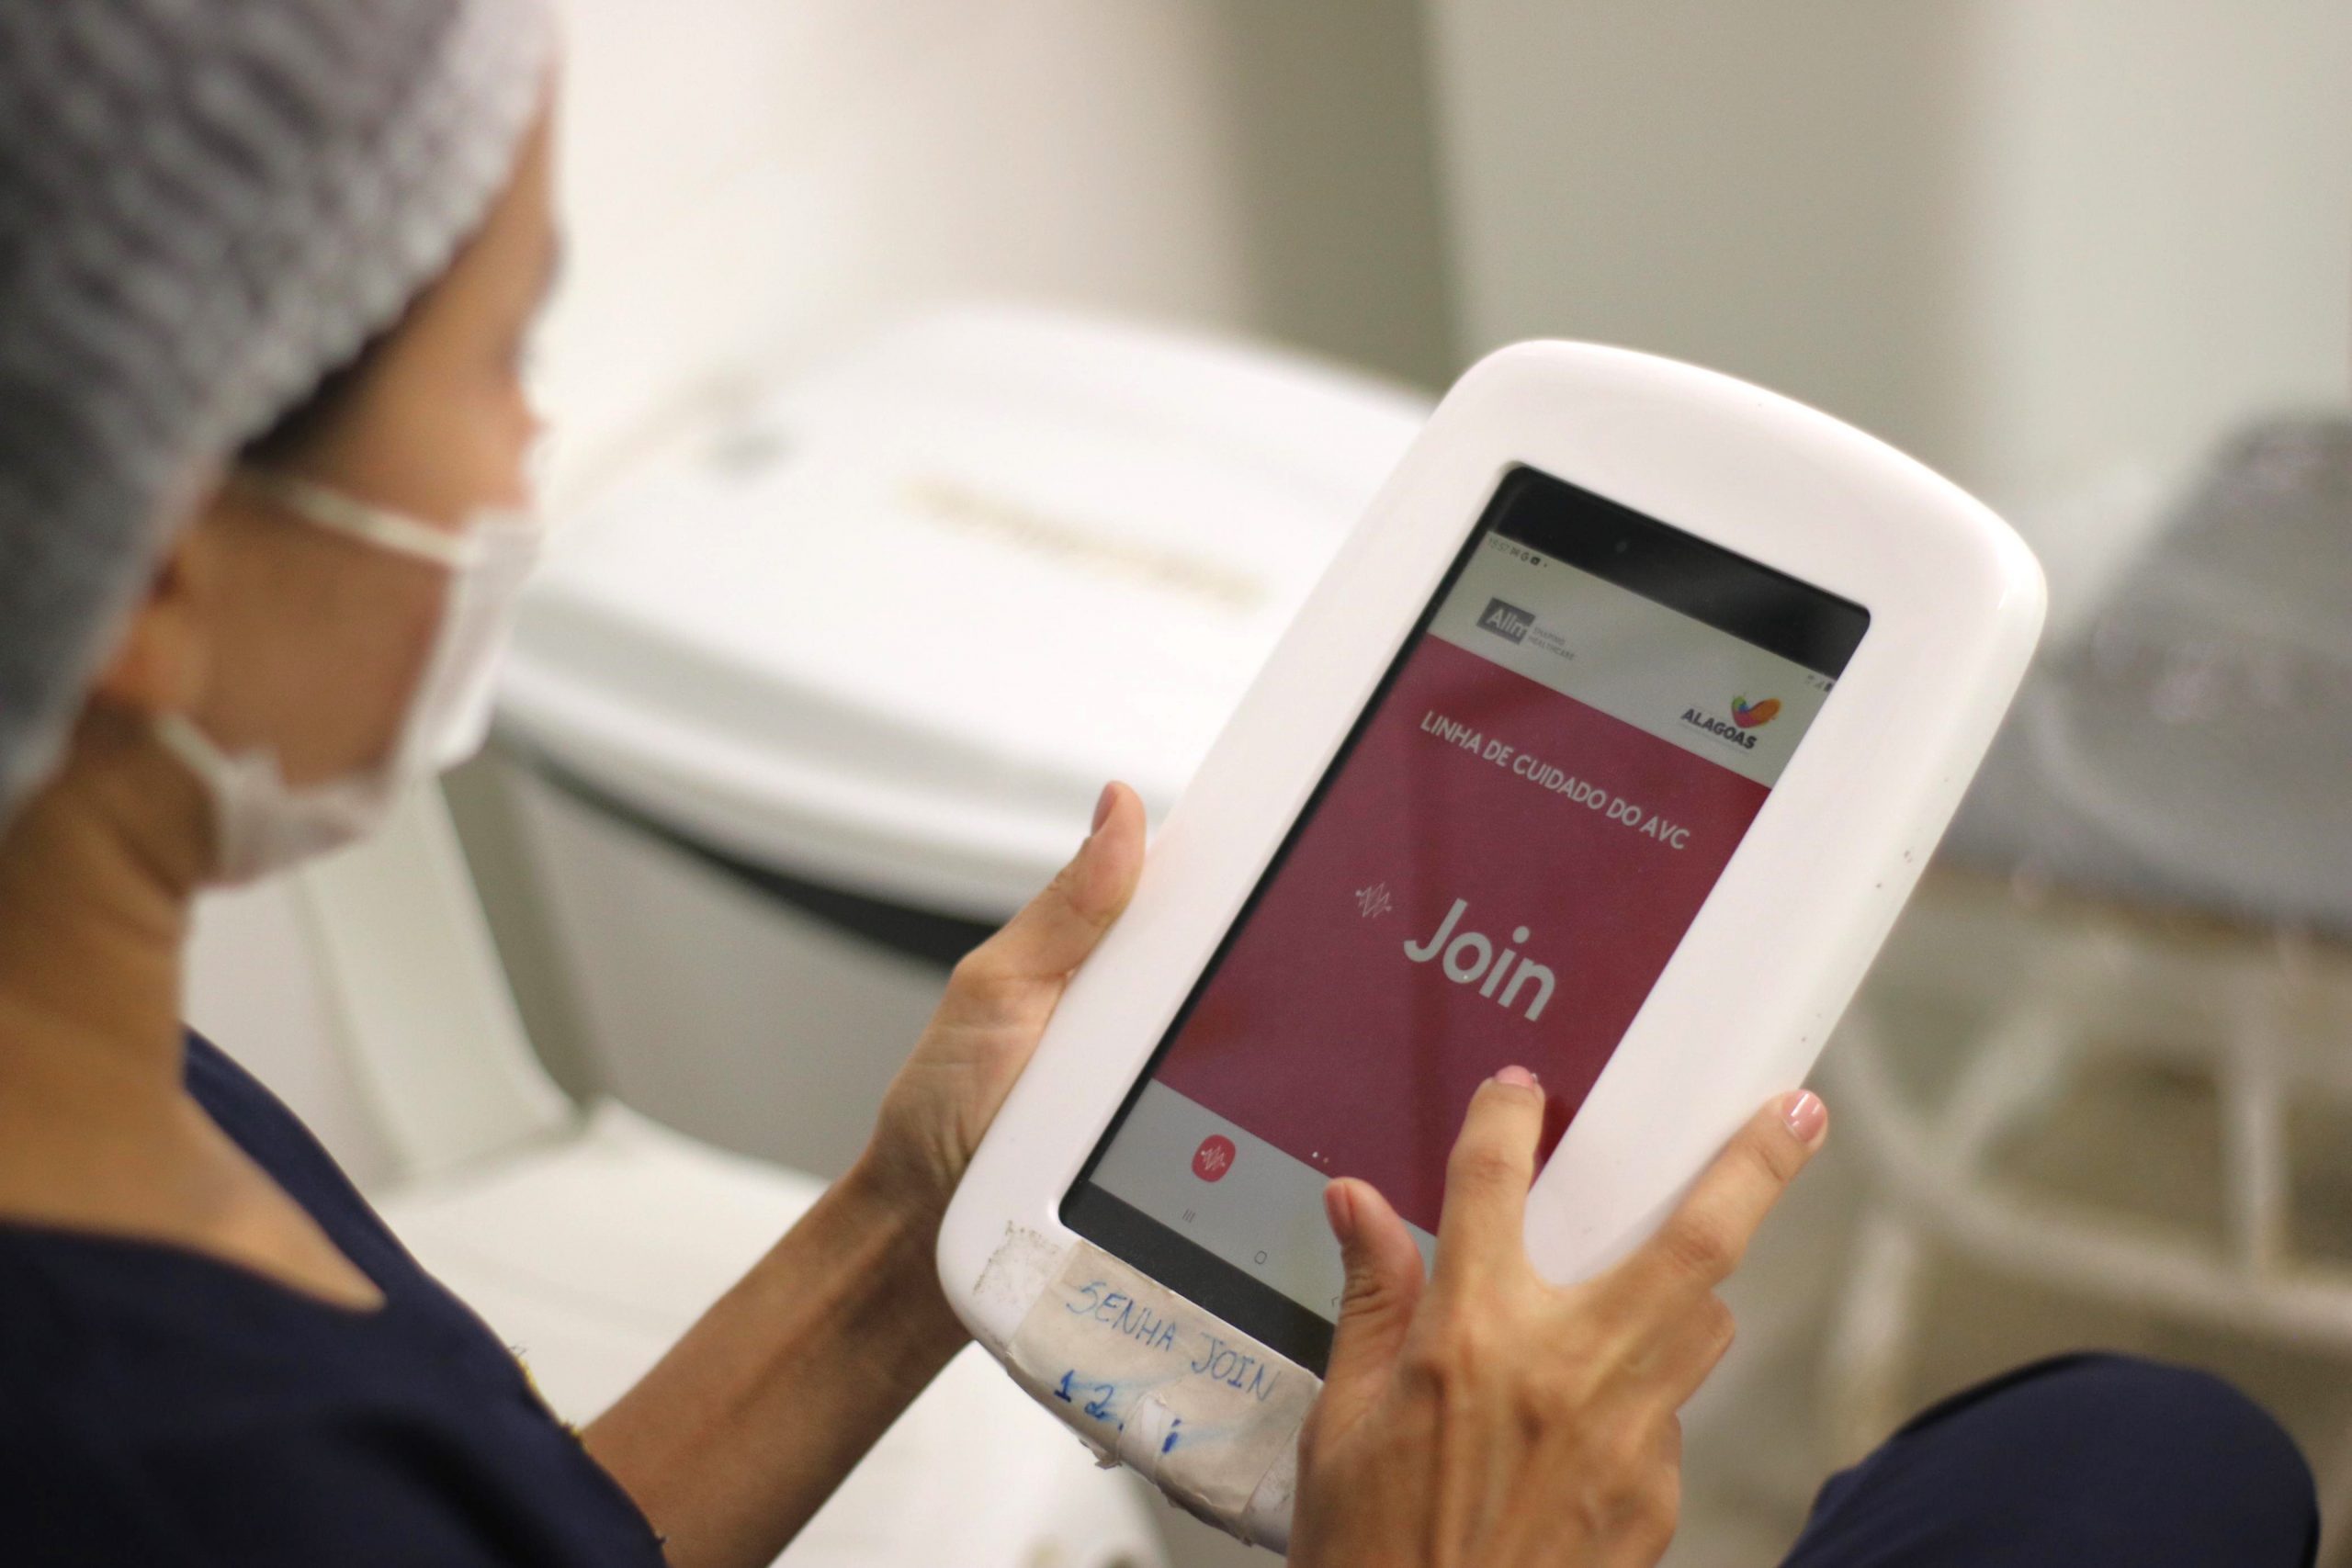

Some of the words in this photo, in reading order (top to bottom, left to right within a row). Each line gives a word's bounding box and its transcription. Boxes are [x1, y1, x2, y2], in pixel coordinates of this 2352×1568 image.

[1419, 710, 1482, 755] LINHA
[1482, 739, 1515, 768] DE
[1512, 754, 1607, 811] CUIDADO
[1606, 795, 1643, 827] DO
[1639, 815, 1690, 850] AVC
[1681, 707, 1758, 750] ALAGOAS
[1403, 897, 1555, 1022] Join
[1065, 1280, 1175, 1353] SENHA
[1191, 1333, 1282, 1402] JOIN
